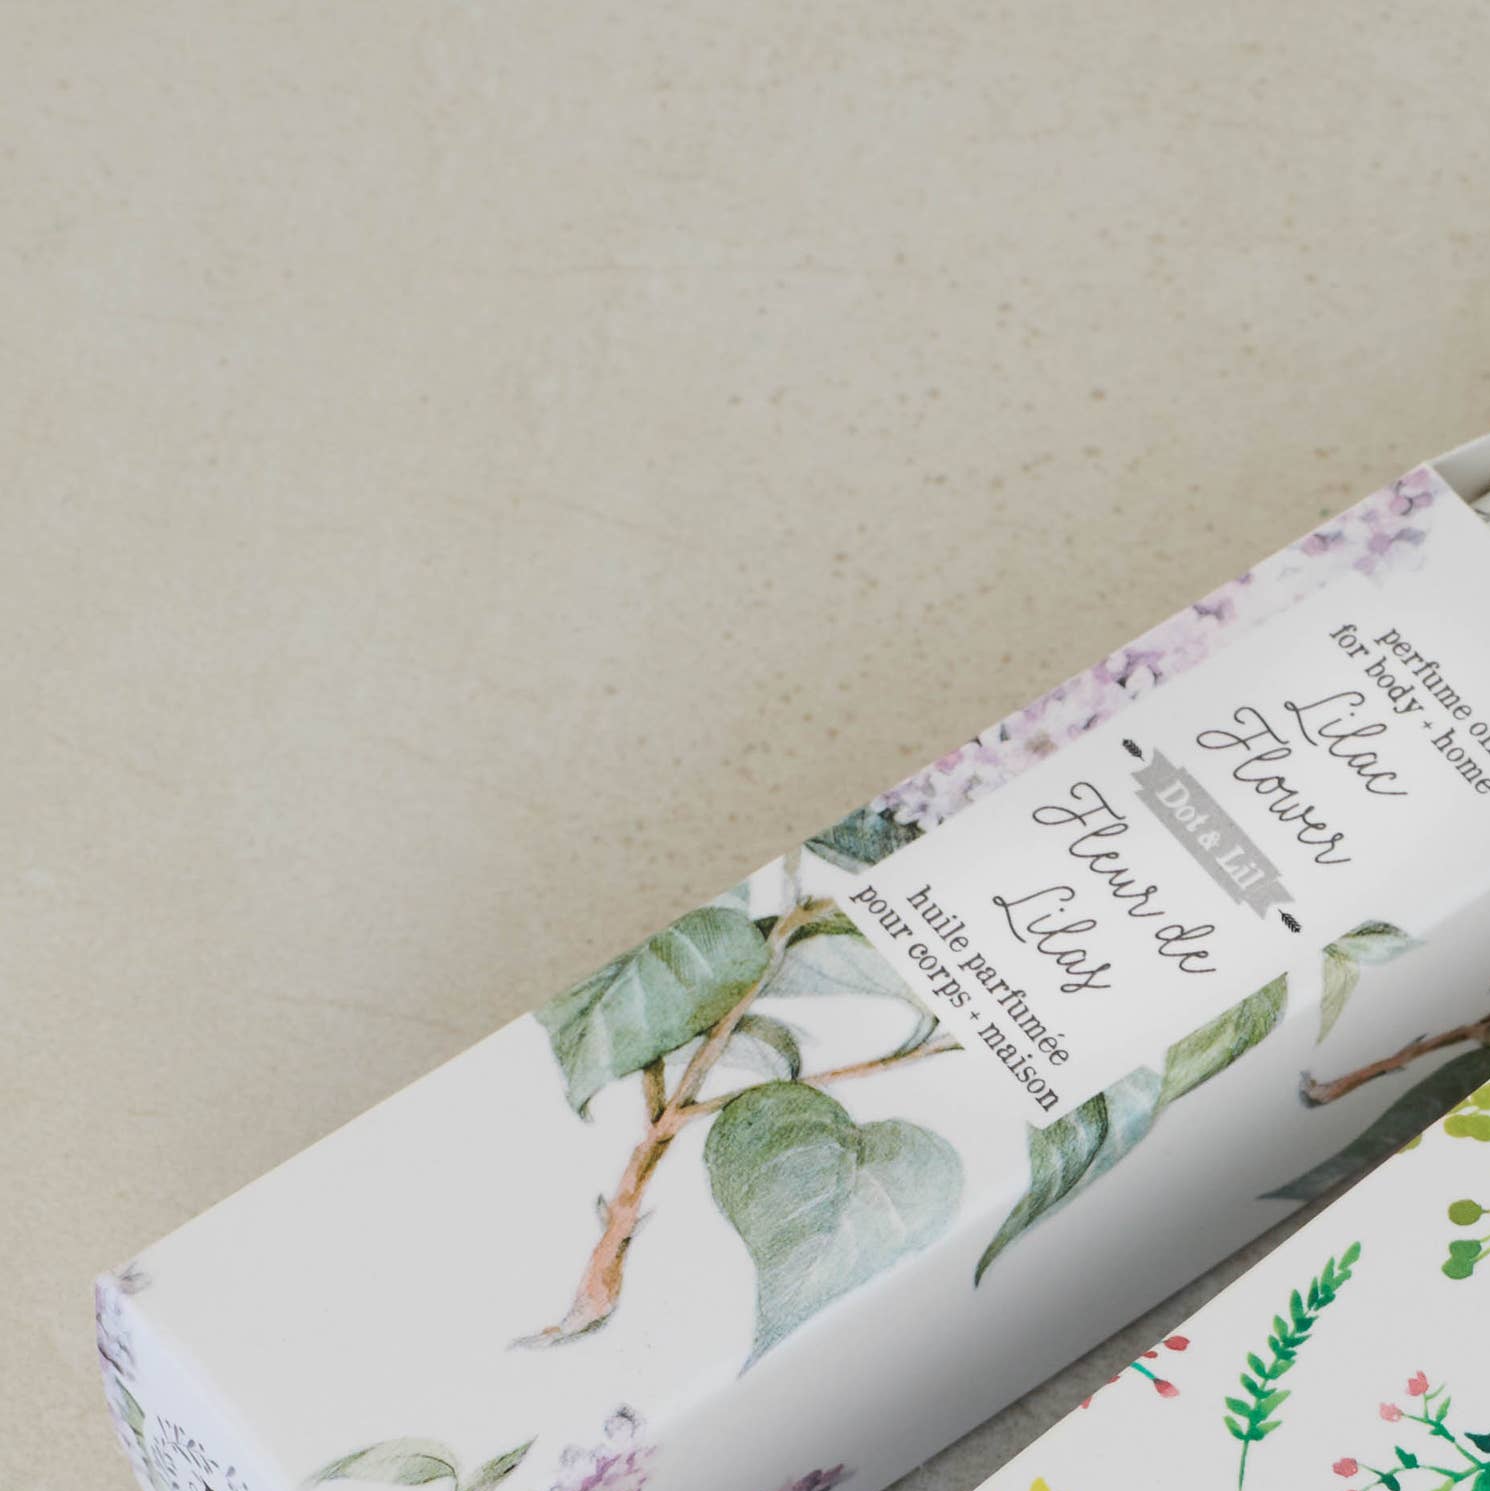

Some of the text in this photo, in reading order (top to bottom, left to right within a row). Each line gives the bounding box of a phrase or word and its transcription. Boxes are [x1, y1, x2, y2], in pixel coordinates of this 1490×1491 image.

[1328, 623, 1371, 659] for
[1363, 655, 1425, 715] body
[1372, 627, 1473, 721] perfume
[1195, 705, 1352, 865] Flower
[1282, 690, 1409, 796] Lilac
[1031, 780, 1217, 974] Fleur de
[1156, 778, 1263, 892] Dot Lil
[905, 883, 1070, 1067] huile parfumée
[991, 884, 1112, 995] Lilas
[848, 884, 1060, 1113] pour corps maison
